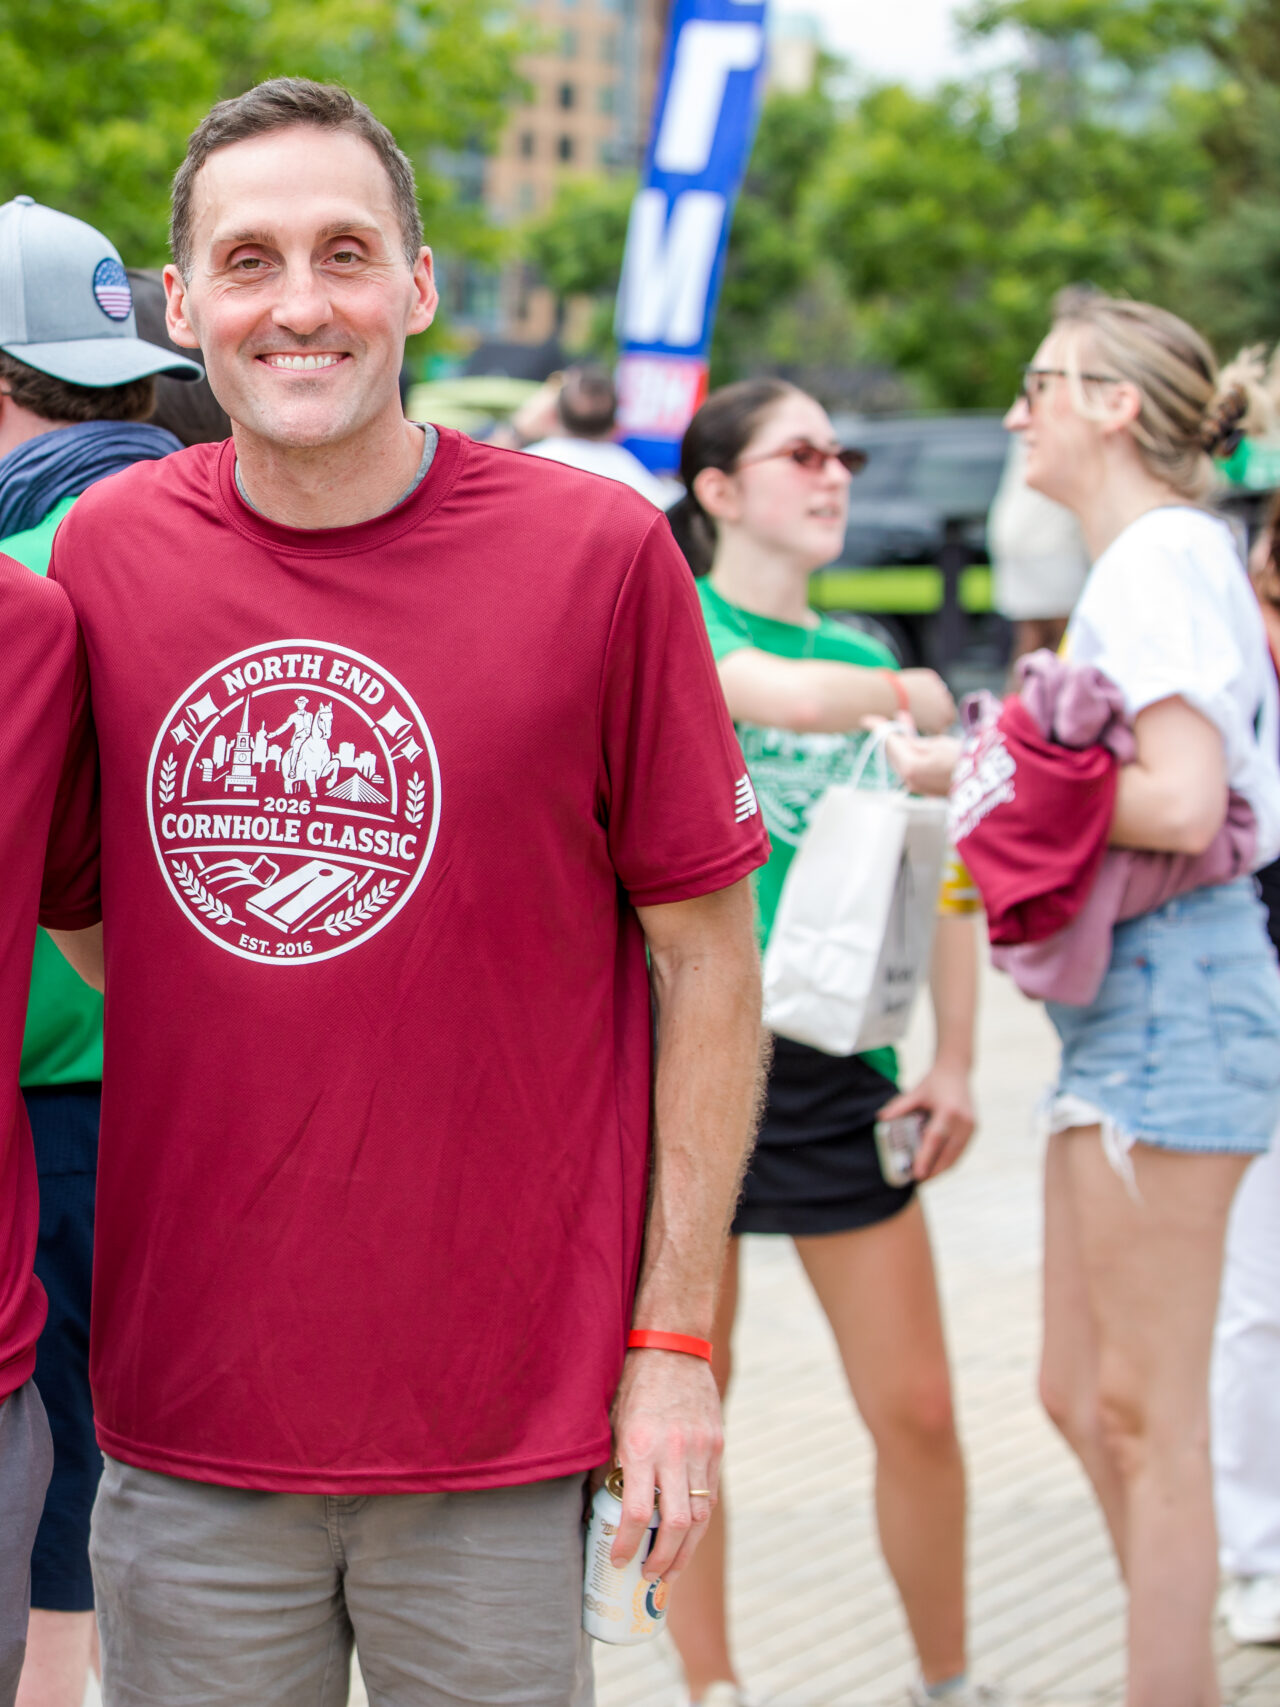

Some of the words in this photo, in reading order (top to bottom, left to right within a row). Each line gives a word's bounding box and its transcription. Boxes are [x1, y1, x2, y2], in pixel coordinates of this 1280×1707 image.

[221, 654, 324, 696] NORTH
[326, 660, 386, 705] END
[263, 797, 311, 815] 2026
[161, 814, 301, 843] CORNHOLE
[306, 821, 417, 860] CLASSIC
[238, 934, 271, 955] EST.
[275, 941, 313, 956] 2016
